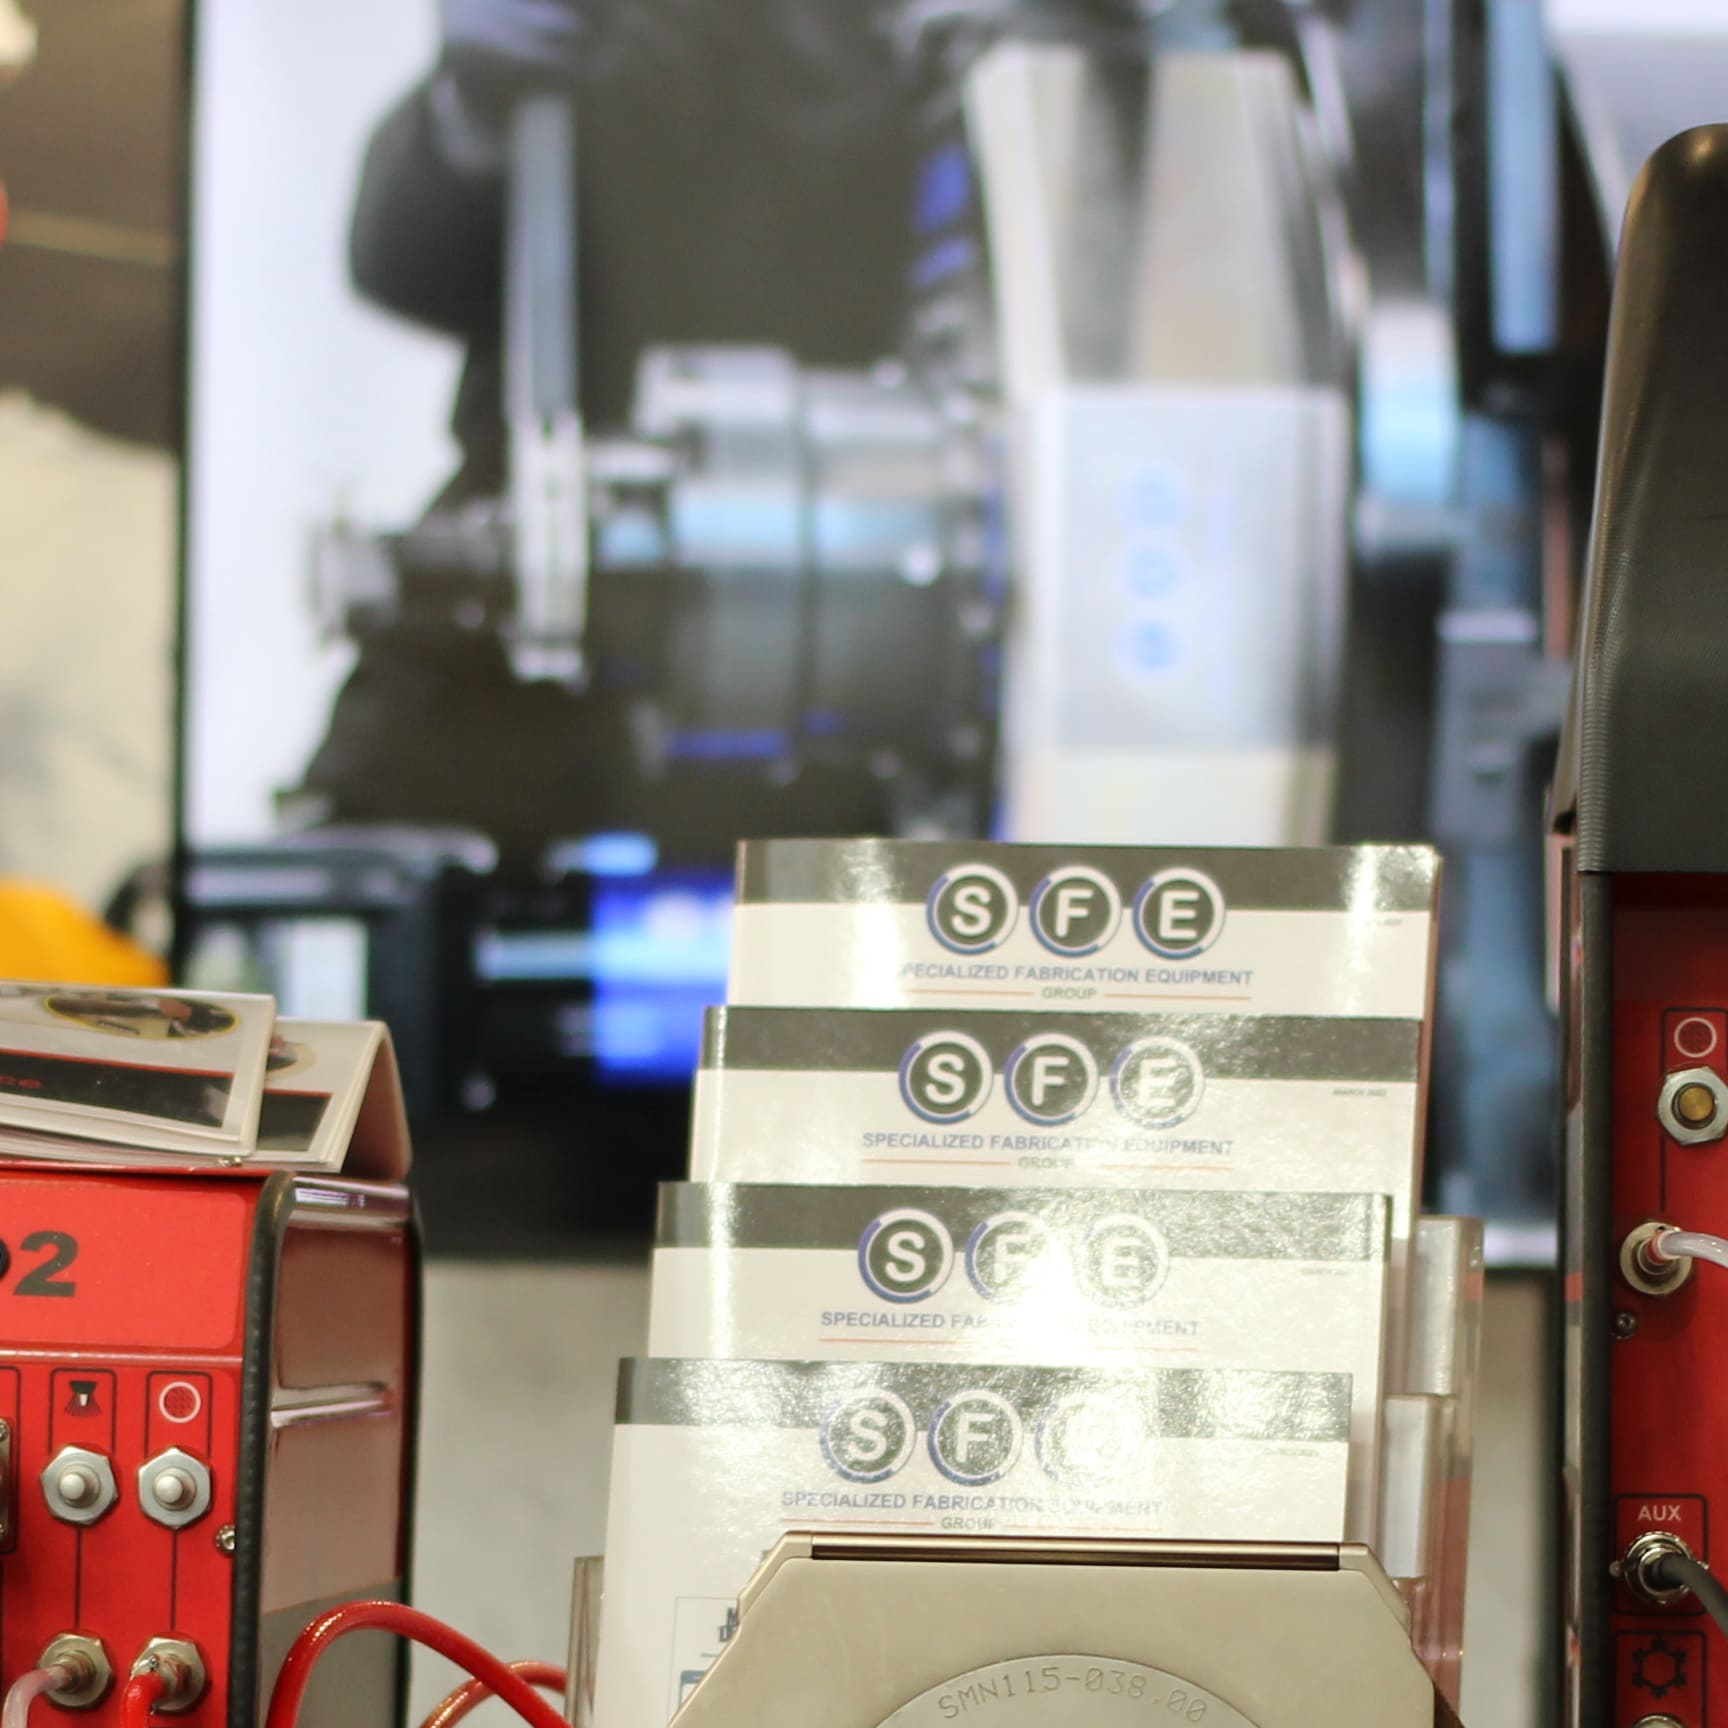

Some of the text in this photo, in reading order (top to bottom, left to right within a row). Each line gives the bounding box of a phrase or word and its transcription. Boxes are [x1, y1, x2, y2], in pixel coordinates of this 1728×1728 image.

[1015, 965, 1140, 985] FABRICATION
[1145, 967, 1253, 986] EQUIPMENT
[1041, 986, 1098, 1001] GROUP
[862, 1131, 985, 1151] SPECIALIZED
[12, 1229, 80, 1298] 2
[820, 1310, 946, 1330] SPECIALIZED
[782, 1490, 906, 1510] SPECIALIZED
[912, 1493, 1042, 1513] FABRICATION
[1637, 1505, 1682, 1522] AUX
